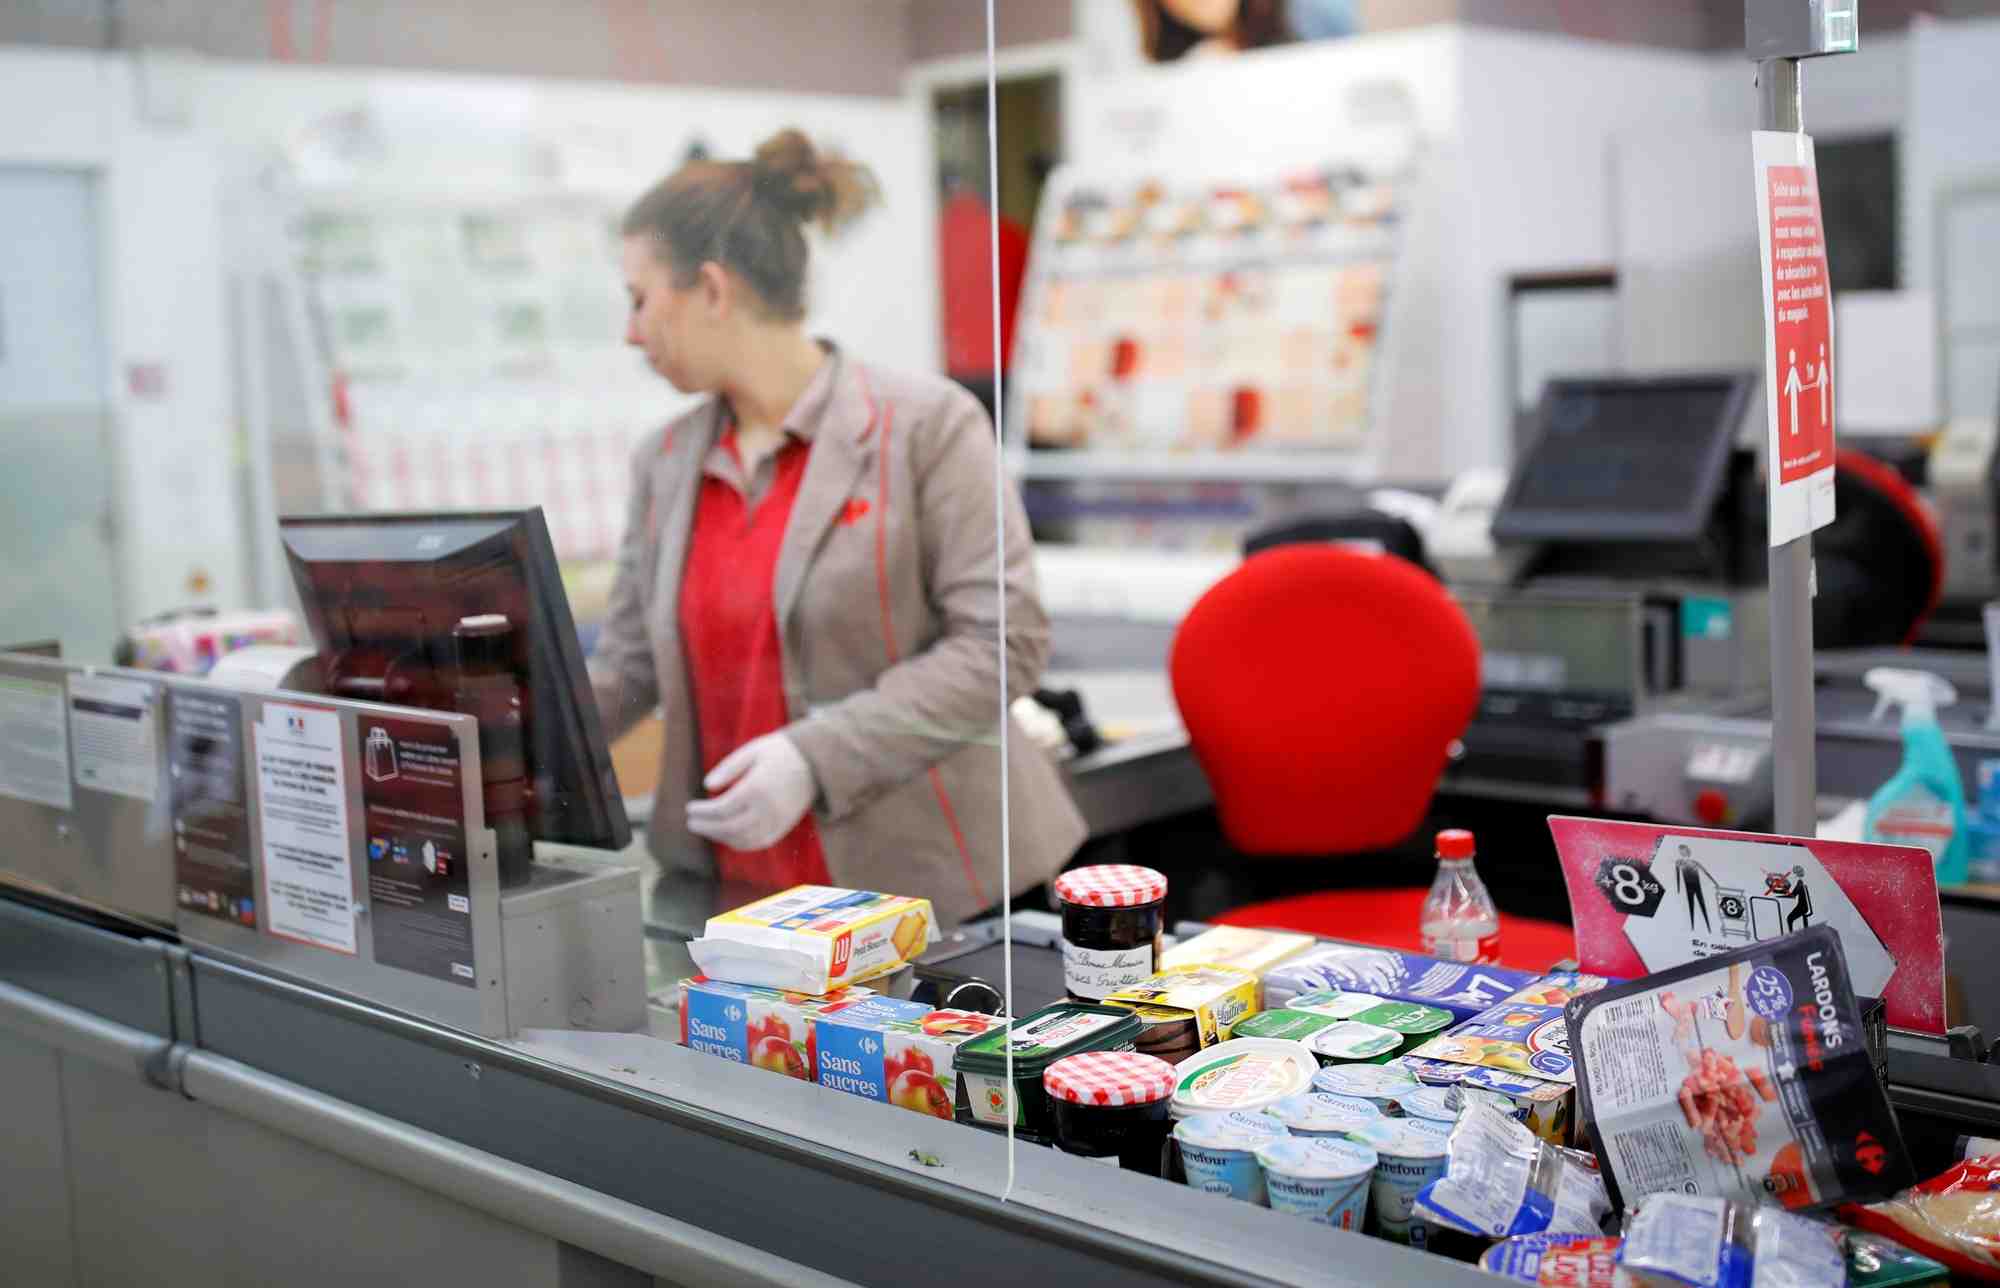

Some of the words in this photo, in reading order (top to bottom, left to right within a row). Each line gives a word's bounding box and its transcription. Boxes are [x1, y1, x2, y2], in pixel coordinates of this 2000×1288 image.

[834, 937, 851, 965] LU
[1806, 951, 1843, 1049] LARDONS
[690, 1017, 727, 1042] Sans
[692, 1038, 742, 1062] sucres
[821, 1051, 862, 1076] Sans
[823, 1072, 879, 1098] sucres
[1183, 1149, 1232, 1167] arrefour
[1268, 1180, 1327, 1197] arrefour
